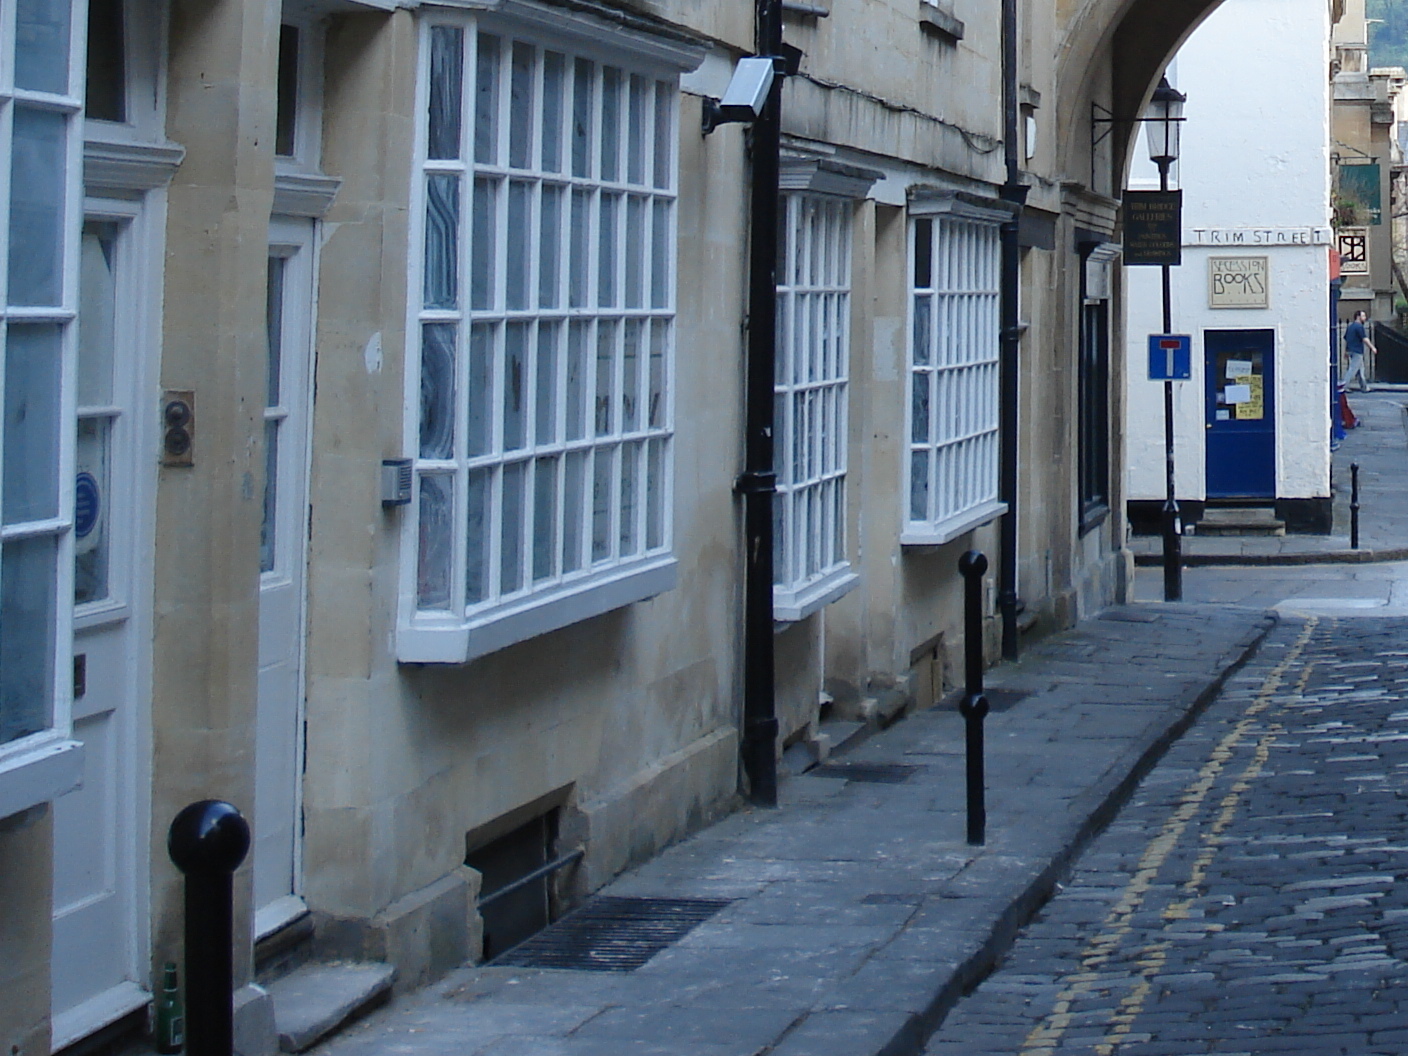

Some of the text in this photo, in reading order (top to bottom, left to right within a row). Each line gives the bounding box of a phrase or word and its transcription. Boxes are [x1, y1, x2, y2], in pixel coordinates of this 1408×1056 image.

[1132, 212, 1173, 221] GALLERIES
[1193, 230, 1321, 244] TRIM STREET
[1213, 260, 1265, 272] SECESSION
[1213, 273, 1265, 295] BOOKS
